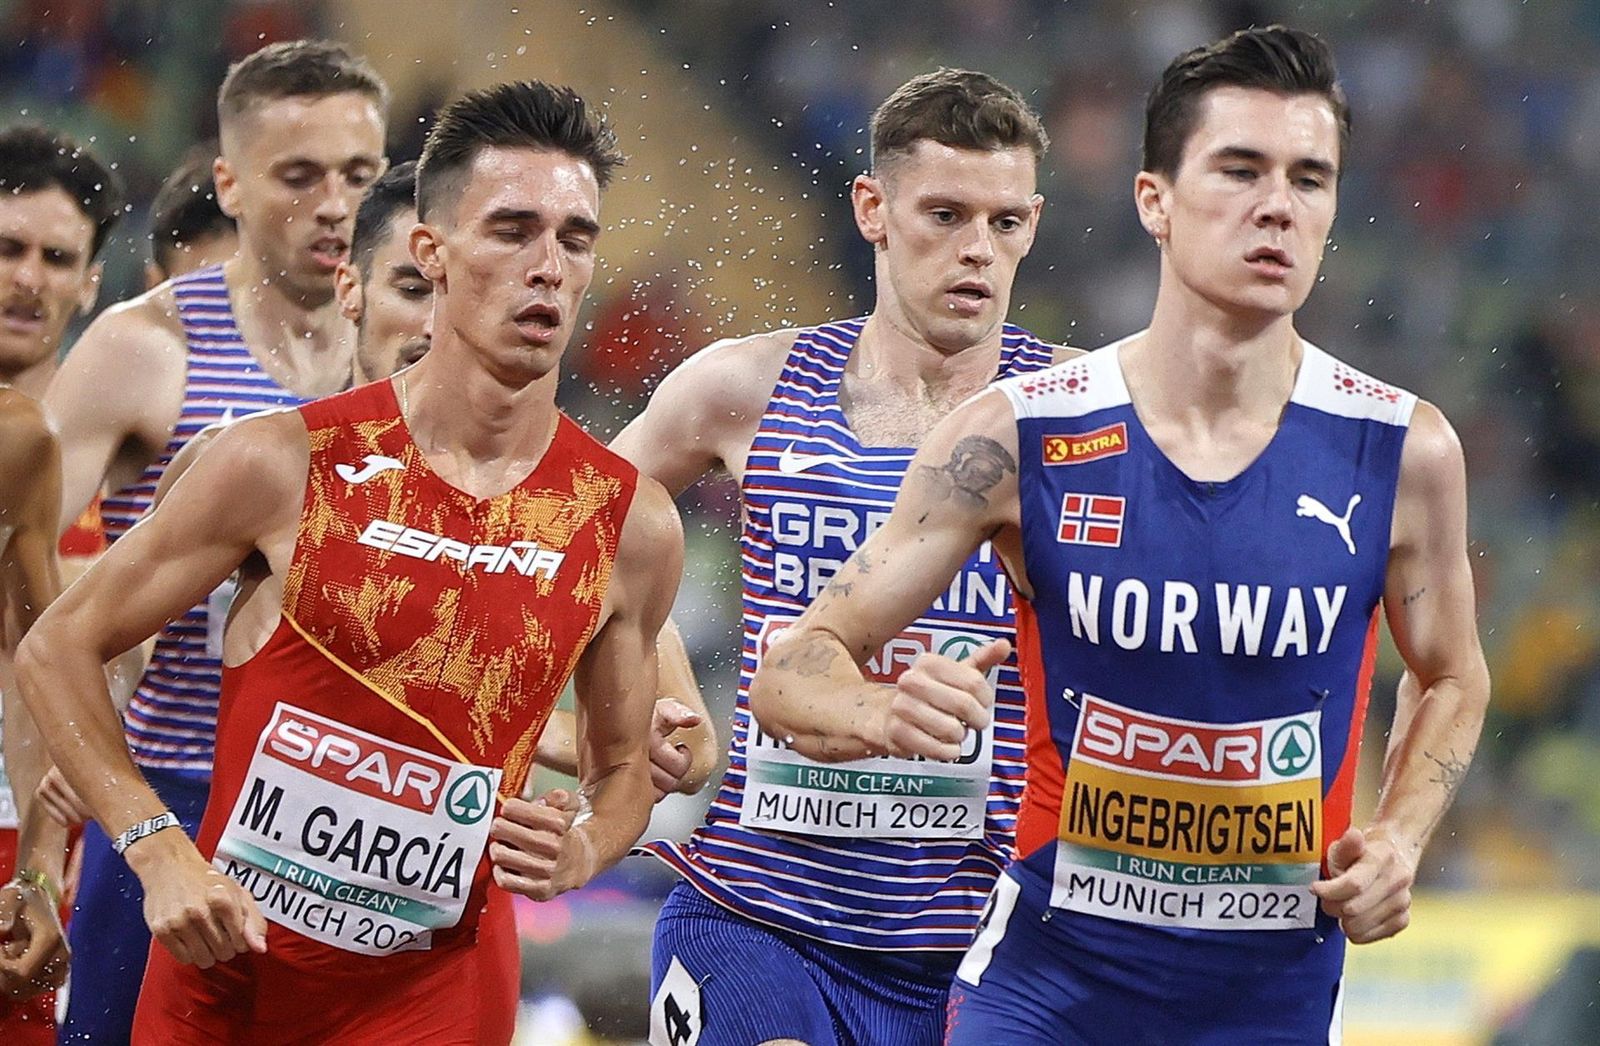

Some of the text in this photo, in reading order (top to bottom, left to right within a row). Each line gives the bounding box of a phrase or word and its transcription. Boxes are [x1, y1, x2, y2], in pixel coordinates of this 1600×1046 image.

[1071, 433, 1122, 456] EXTRA
[357, 520, 566, 579] ESPAÑA
[1068, 571, 1348, 658] NORWAY
[270, 719, 443, 807] SPAR
[1083, 709, 1259, 773] SPAR
[807, 769, 849, 791] RUN
[238, 777, 467, 899] M. GARCÍA
[755, 791, 969, 829] MUNICH 2022
[1068, 782, 1315, 855] INGEBRIGTSEN
[273, 858, 282, 875] I
[285, 864, 331, 896] RUN
[1069, 872, 1301, 919] MUNICH 2022
[1115, 854, 1122, 870] I
[1129, 857, 1175, 881] RUN
[225, 860, 348, 937] MUNICH
